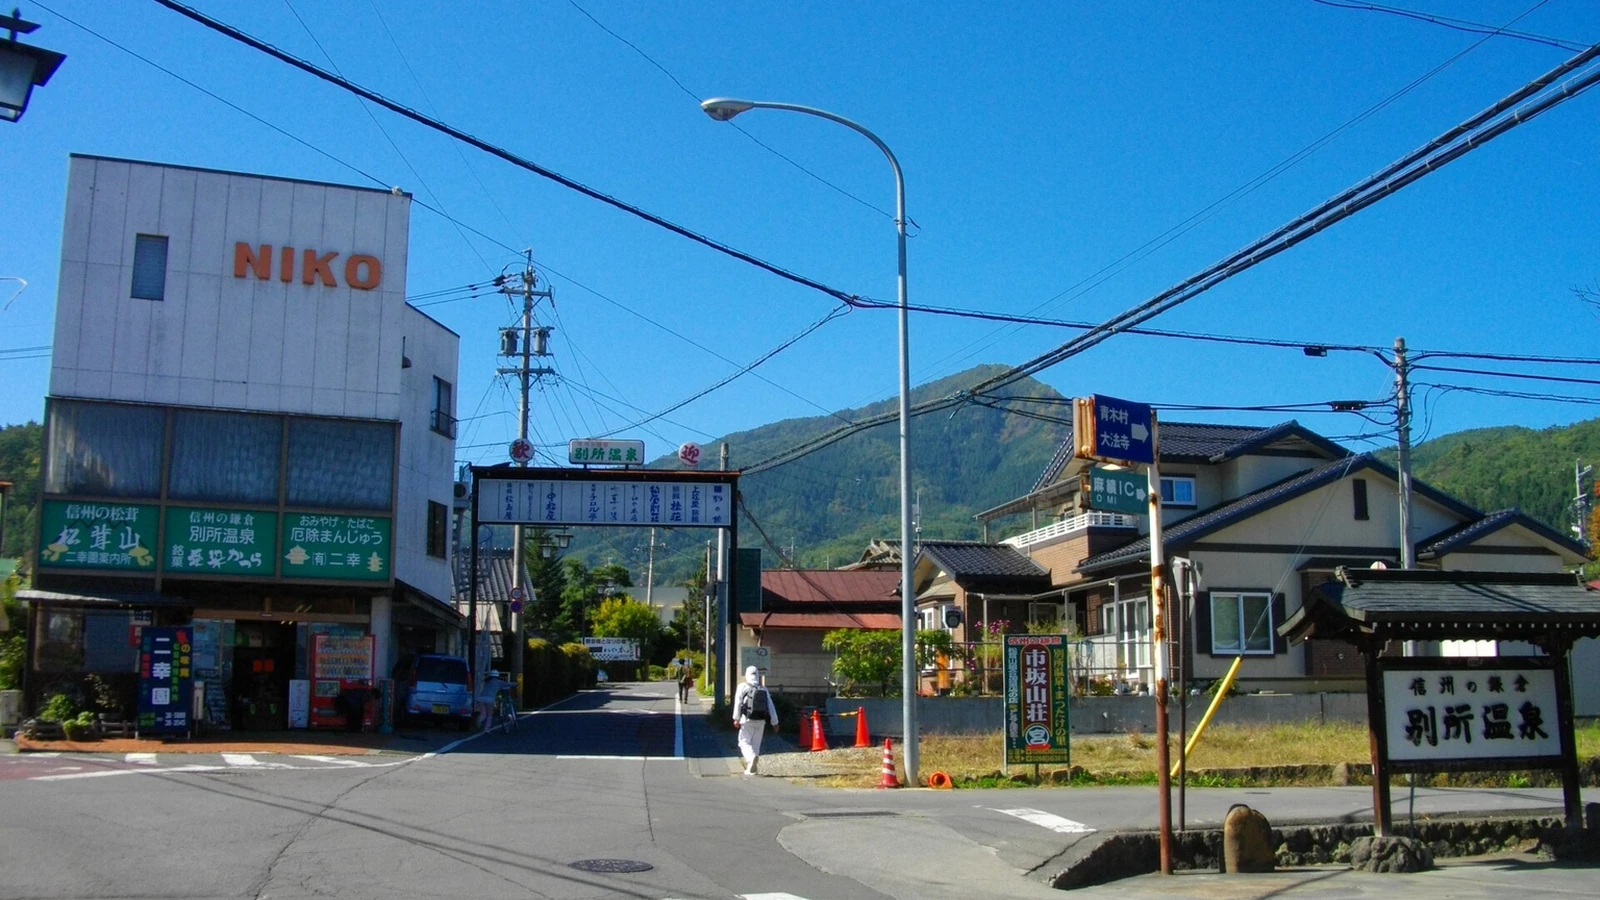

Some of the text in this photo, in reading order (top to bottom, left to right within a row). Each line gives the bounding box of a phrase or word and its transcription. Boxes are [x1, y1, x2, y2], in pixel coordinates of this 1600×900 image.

[234, 242, 382, 290] NIKO
[1100, 405, 1129, 425] 青木村
[512, 441, 530, 460] 歓
[1100, 431, 1130, 451] 大法寺
[575, 447, 638, 461] 別所温泉
[681, 444, 700, 464] 迎
[66, 505, 139, 522] 信州の松茸
[189, 511, 255, 526] 信州の鎌倉
[56, 525, 140, 550] 松茸山
[189, 525, 255, 544] 別所温泉
[291, 527, 383, 545] 厄除まんじゅう
[171, 545, 184, 568] 銘菓
[1025, 649, 1049, 723] 市坂山荘
[1408, 674, 1530, 696] 信州の鎌倉
[1405, 701, 1549, 747] 別所温泉
